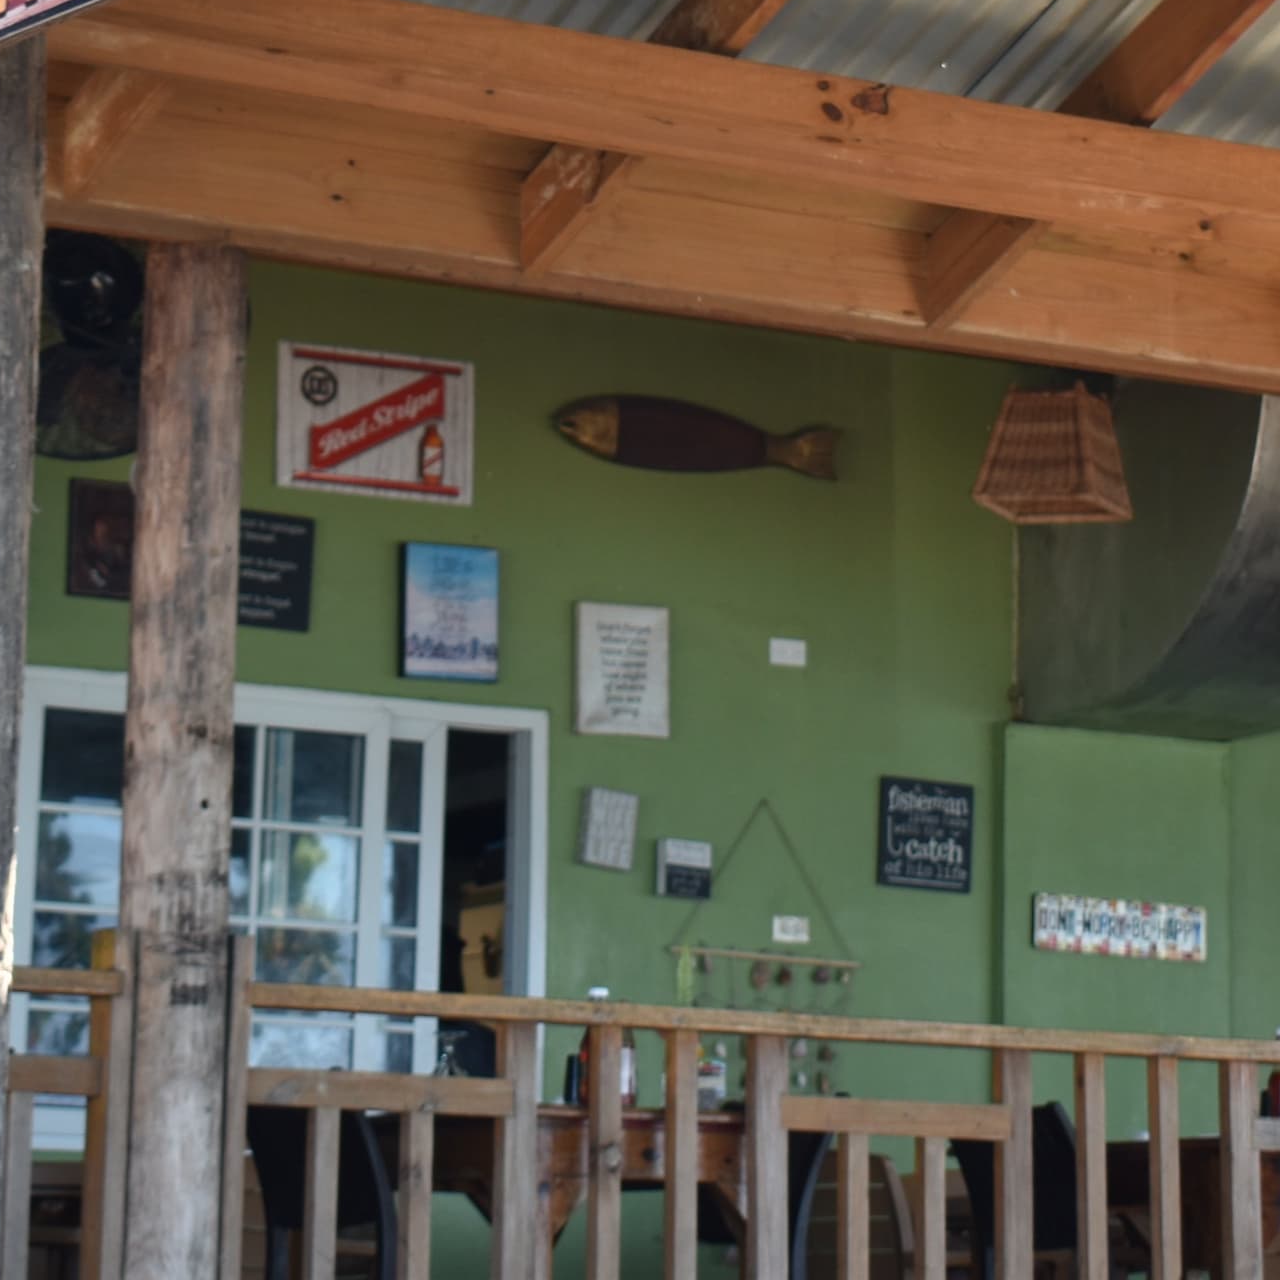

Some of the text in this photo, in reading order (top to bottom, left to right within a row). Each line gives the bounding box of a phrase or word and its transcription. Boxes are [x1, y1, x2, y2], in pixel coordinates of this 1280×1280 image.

[318, 428, 367, 458] Red
[369, 385, 440, 431] Stripe
[905, 836, 964, 864] catch
